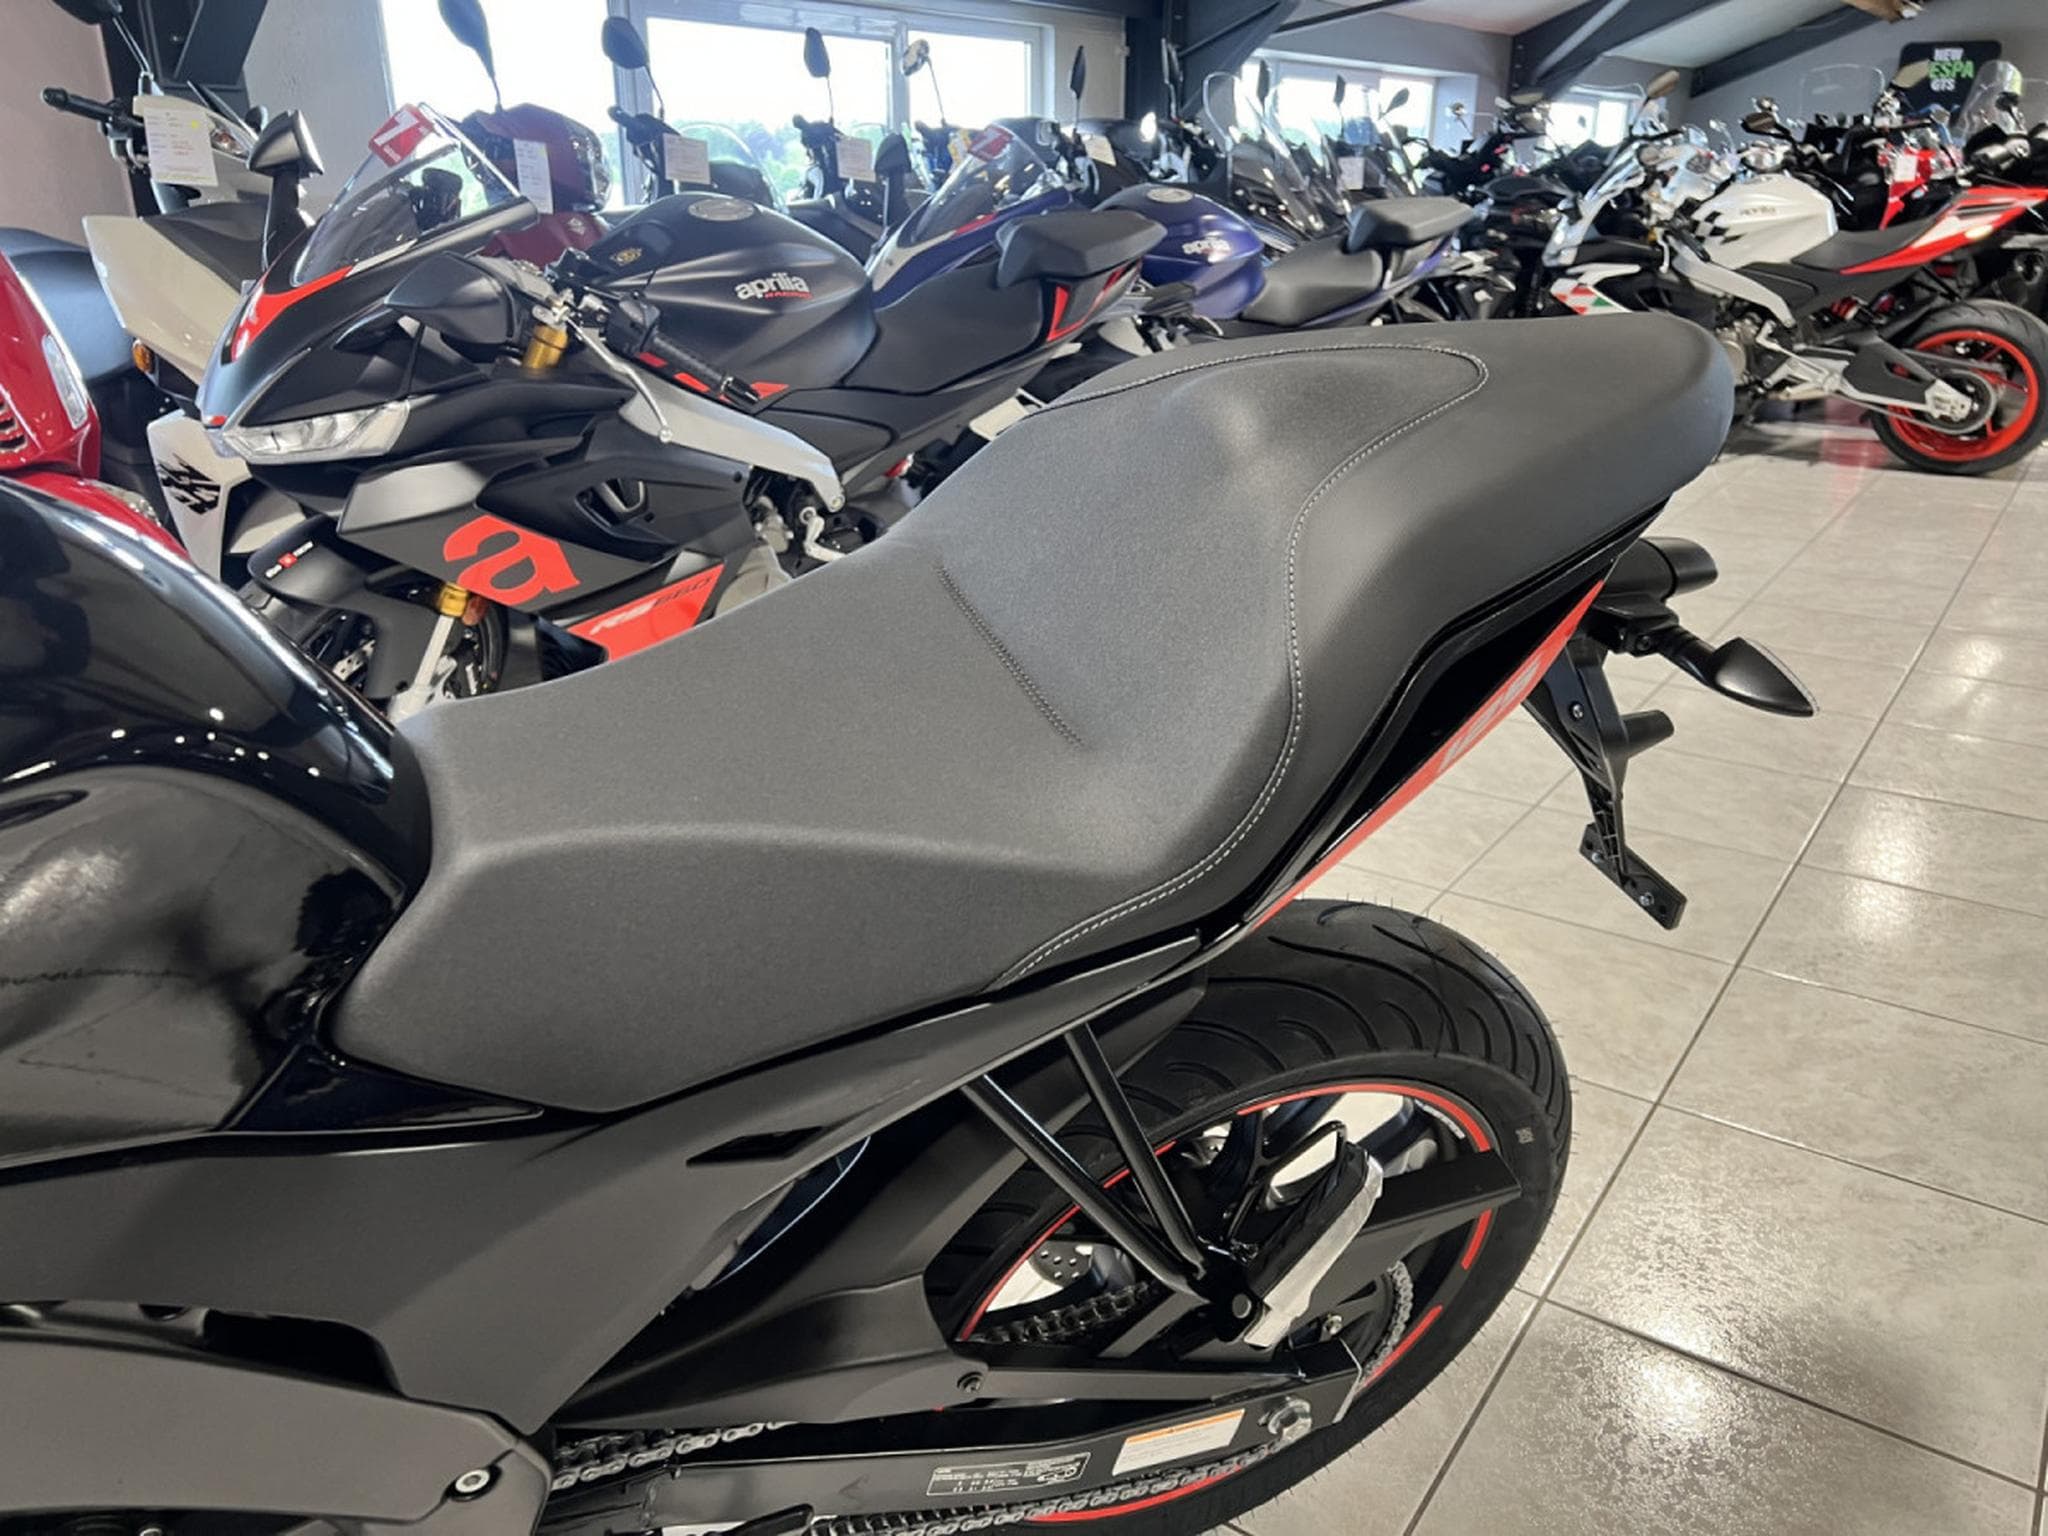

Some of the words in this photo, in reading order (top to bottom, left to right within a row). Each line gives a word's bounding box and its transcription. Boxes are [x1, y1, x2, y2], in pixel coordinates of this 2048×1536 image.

[1933, 48, 1964, 61] NEW
[1928, 60, 1974, 79] ESPA
[735, 272, 810, 300] aprilia
